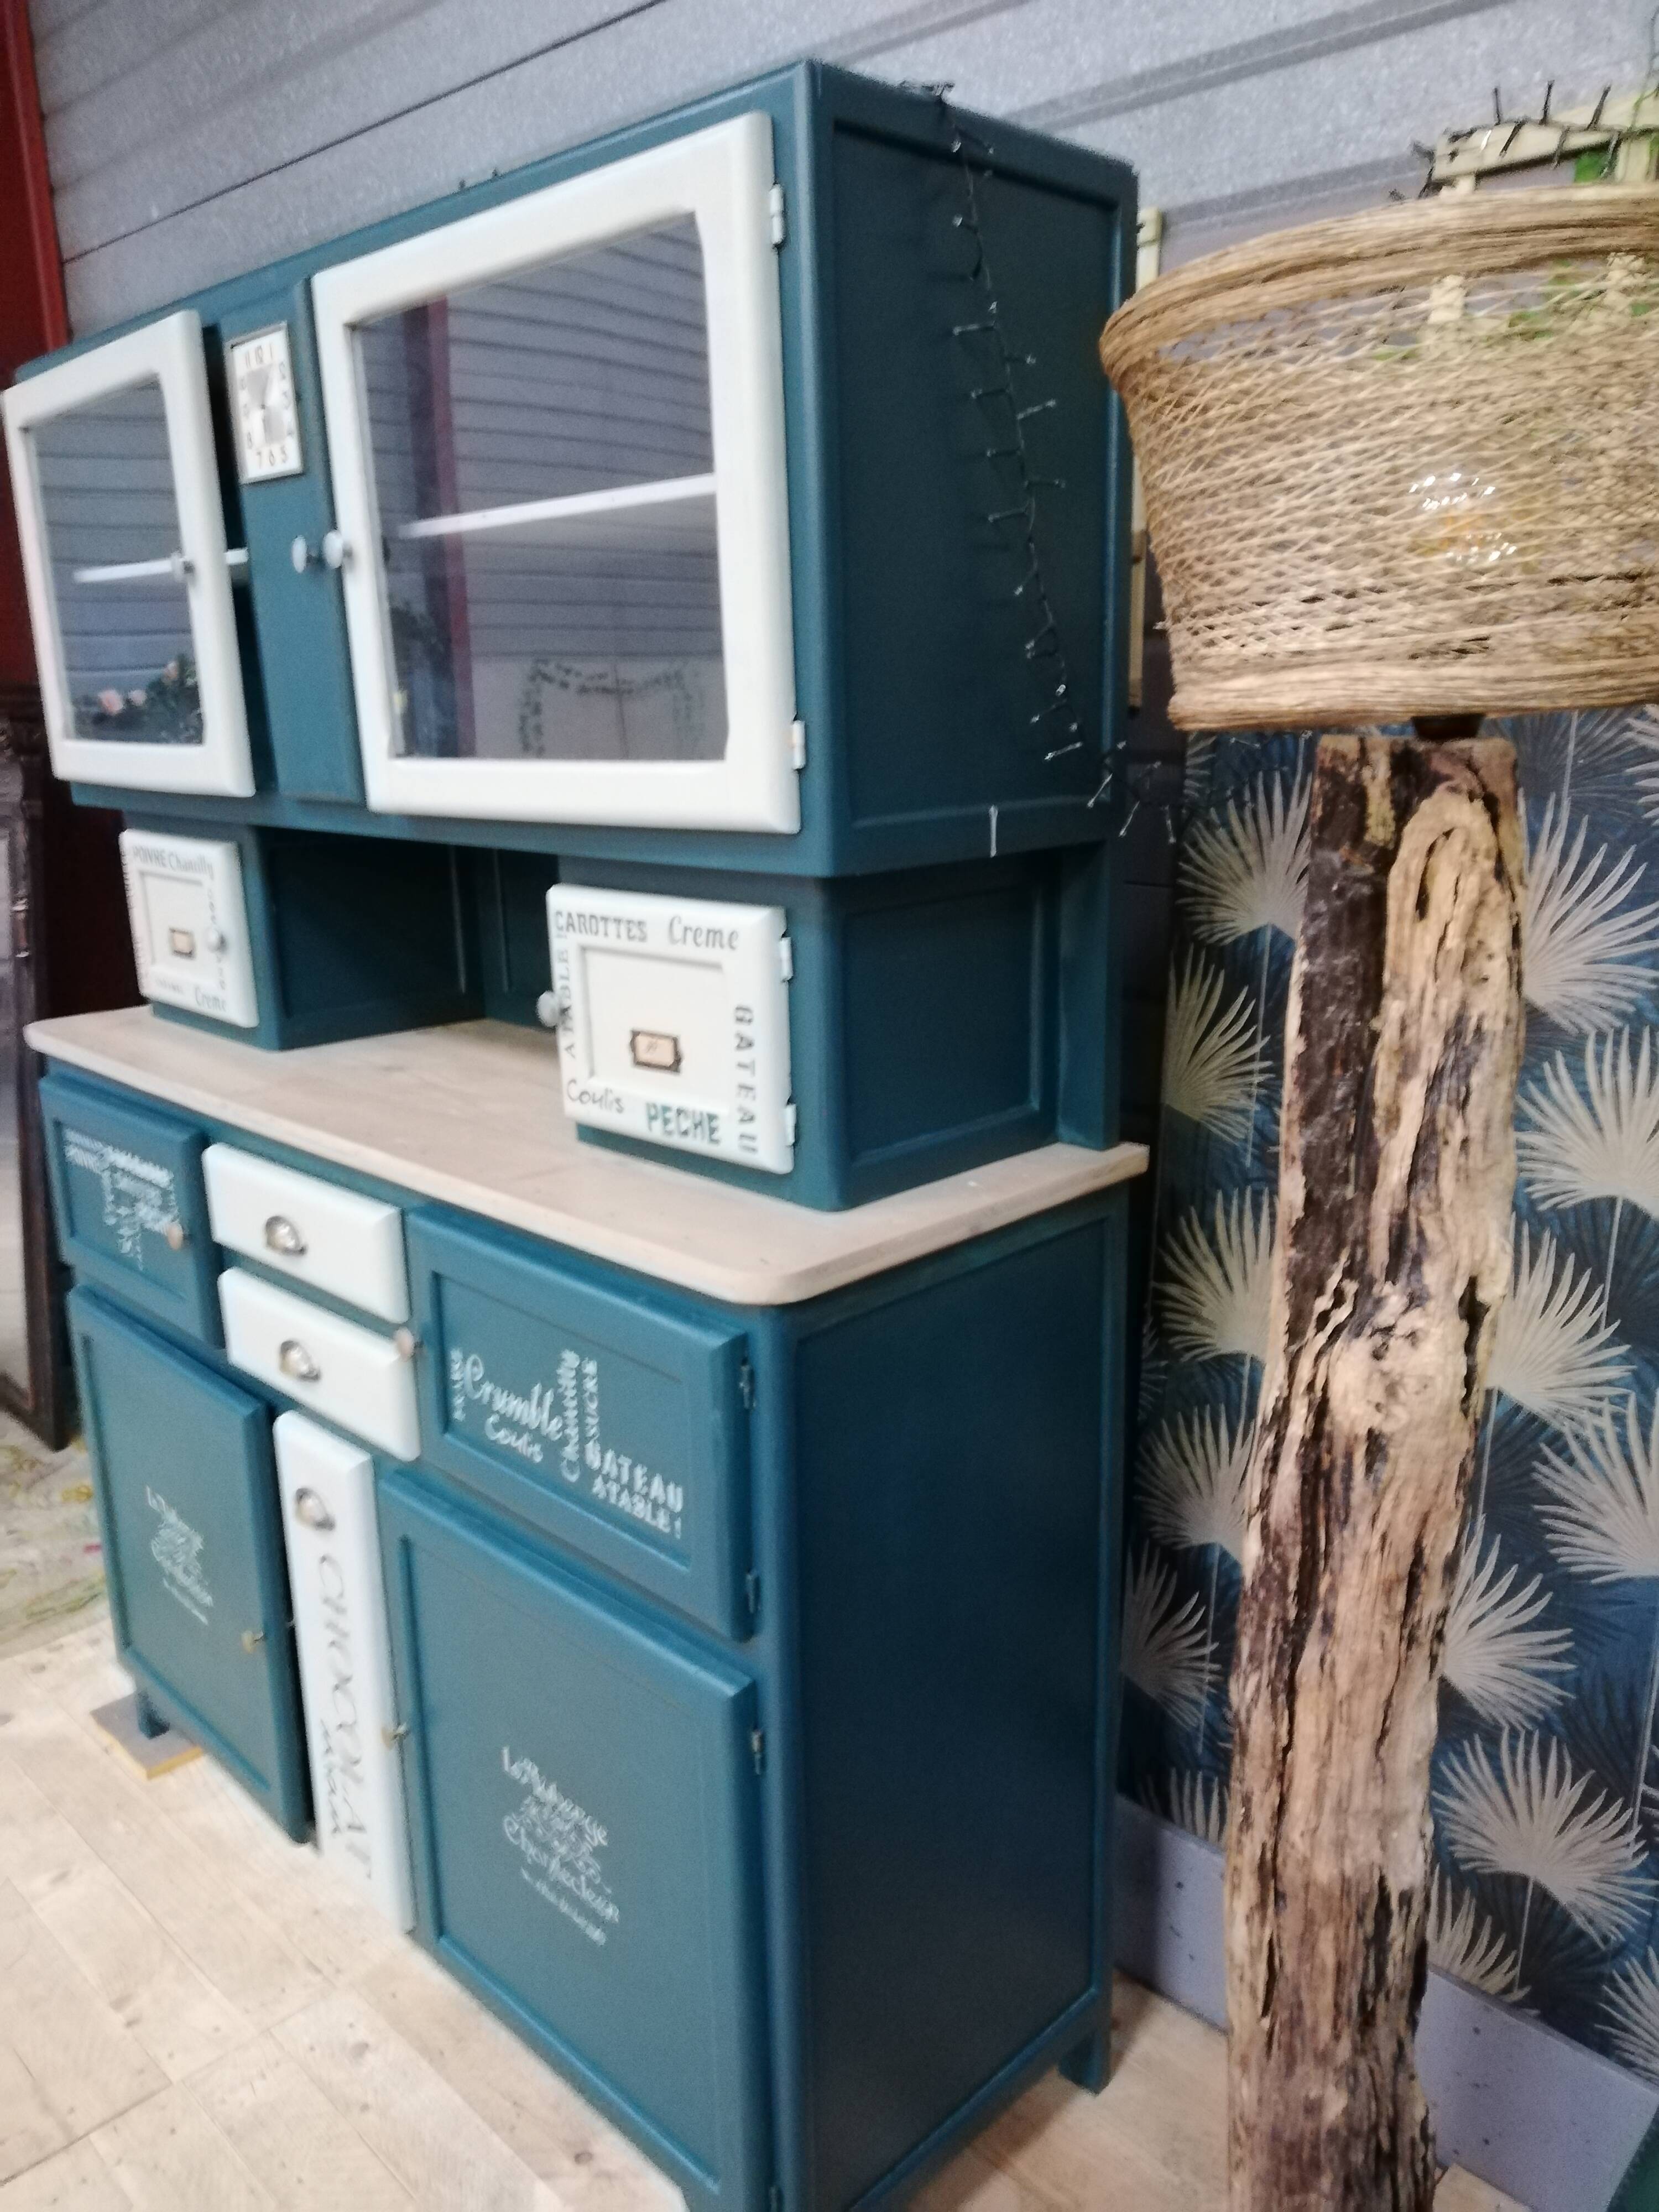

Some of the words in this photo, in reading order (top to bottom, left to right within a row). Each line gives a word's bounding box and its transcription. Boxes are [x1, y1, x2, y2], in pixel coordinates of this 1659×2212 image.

[555, 911, 648, 943] CAROTTES
[668, 915, 740, 951] Creme
[567, 1077, 624, 1114] Coulis
[645, 1102, 722, 1145] PECHE
[734, 1004, 759, 1155] GATEAU
